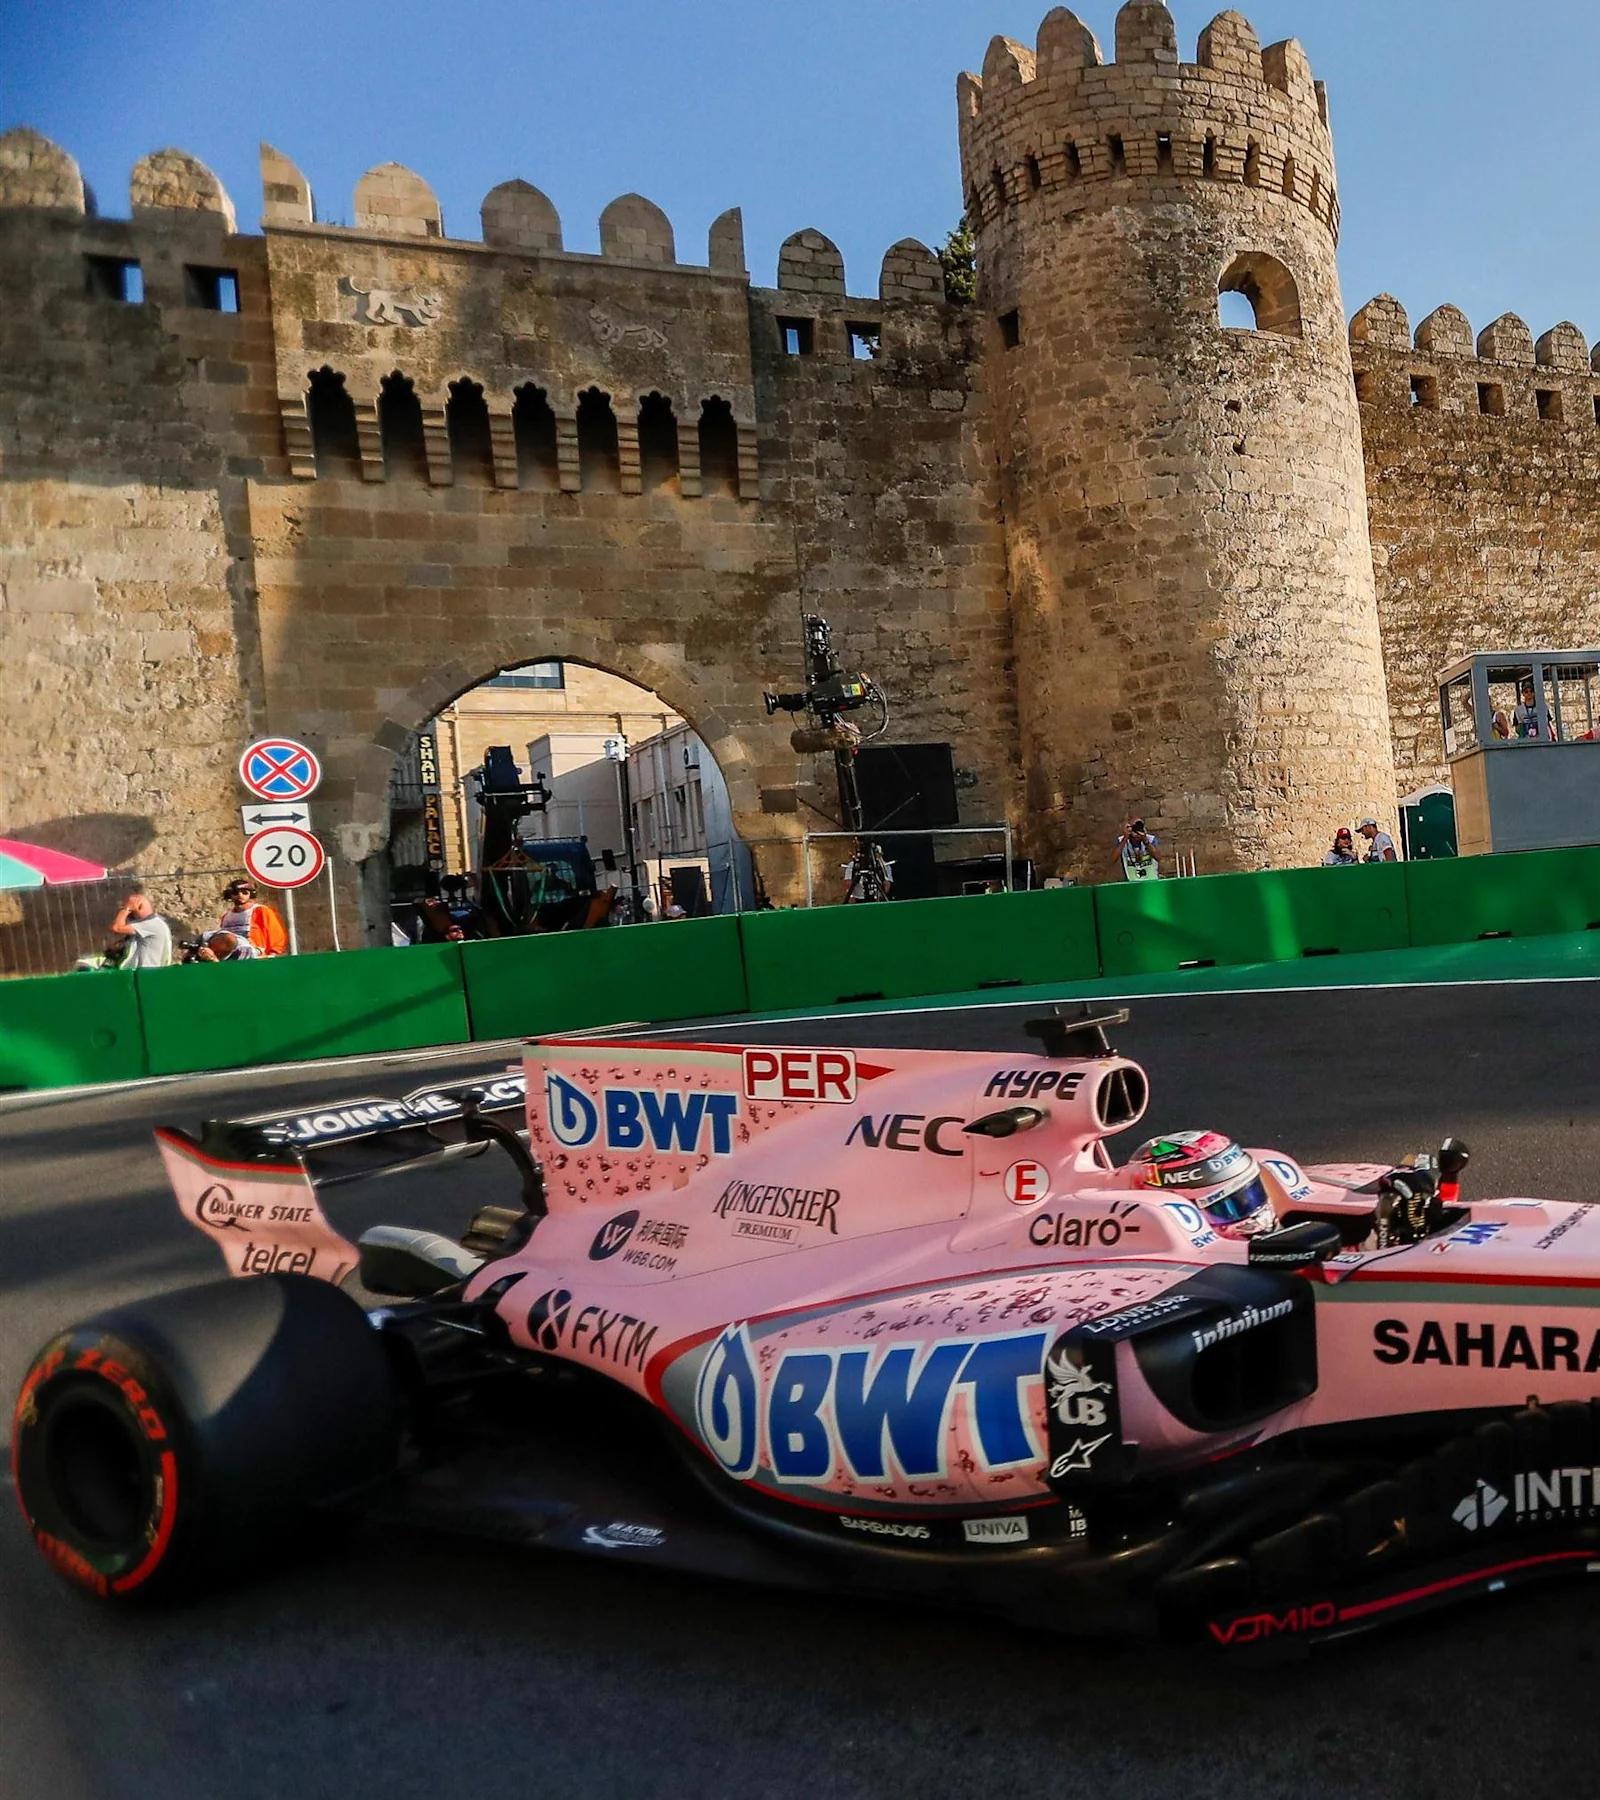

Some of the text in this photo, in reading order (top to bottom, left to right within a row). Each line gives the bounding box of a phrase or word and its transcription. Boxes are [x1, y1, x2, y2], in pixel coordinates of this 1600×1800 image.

[420, 736, 443, 870] SHAH PALAC
[265, 844, 306, 868] 20
[745, 1053, 853, 1099] PER
[983, 1070, 1084, 1100] HYPE
[606, 1088, 740, 1157] BWT
[845, 1114, 967, 1157] NEC
[1014, 1163, 1038, 1201] E
[1163, 1168, 1204, 1185] NEC
[1289, 1186, 1316, 1201] BWT
[209, 1198, 314, 1223] QUAKER STATE
[713, 1180, 841, 1235] KINGFISHER
[737, 1221, 794, 1242] PREMIUM
[1029, 1211, 1121, 1248] Claro
[1190, 1231, 1219, 1248] BWT
[240, 1241, 317, 1276] telcel
[571, 1305, 660, 1373] FXTM
[1191, 1298, 1294, 1353] infinitum
[768, 1328, 1056, 1485] BWT
[965, 1520, 1025, 1537] UNIVA
